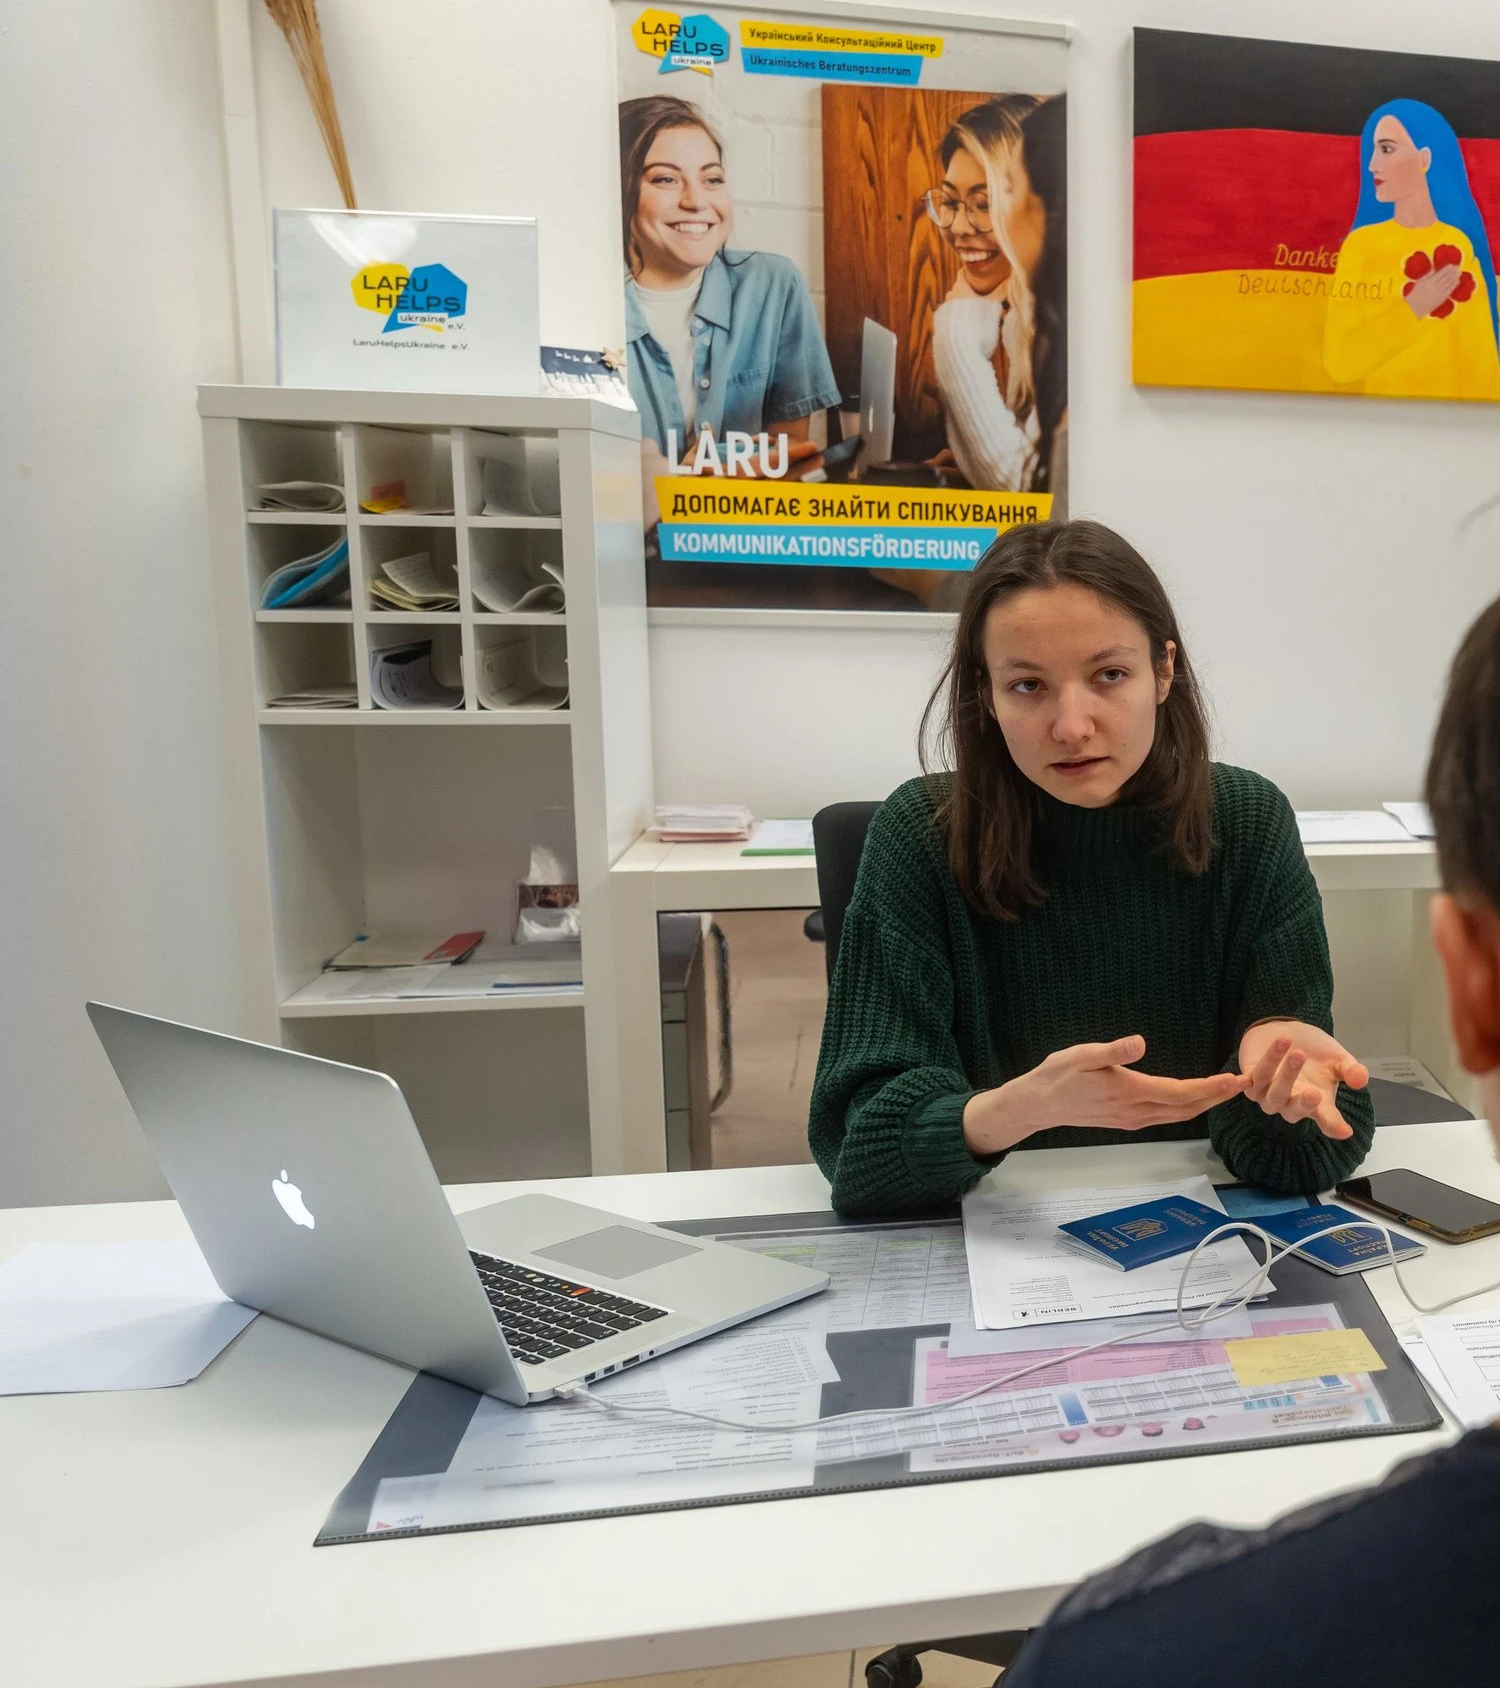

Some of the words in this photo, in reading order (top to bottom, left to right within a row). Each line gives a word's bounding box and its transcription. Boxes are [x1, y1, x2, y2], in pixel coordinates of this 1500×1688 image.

[641, 21, 697, 39] LARU
[749, 27, 814, 44] Український
[815, 32, 904, 51] Консультаційний
[905, 39, 937, 54] Центр
[652, 37, 725, 57] HELPS
[749, 55, 816, 72] Ukrainisches
[818, 60, 912, 77] Beratungszentrum
[1274, 244, 1341, 268] Danke
[363, 275, 429, 292] LARU
[1238, 274, 1393, 301] Deutschland!
[376, 294, 461, 312] HELPS
[400, 314, 446, 324] ukraine
[353, 339, 446, 349] LaruHelpsUkraine
[667, 429, 789, 479] LARU
[672, 493, 801, 517] ДОПОМАГАЄ
[808, 494, 891, 521] ЗНАЙТИ
[897, 501, 1038, 524] СПІЛКУВАННЯ
[673, 533, 980, 560] KOMMUNIKATIONSFÖRDERUNG
